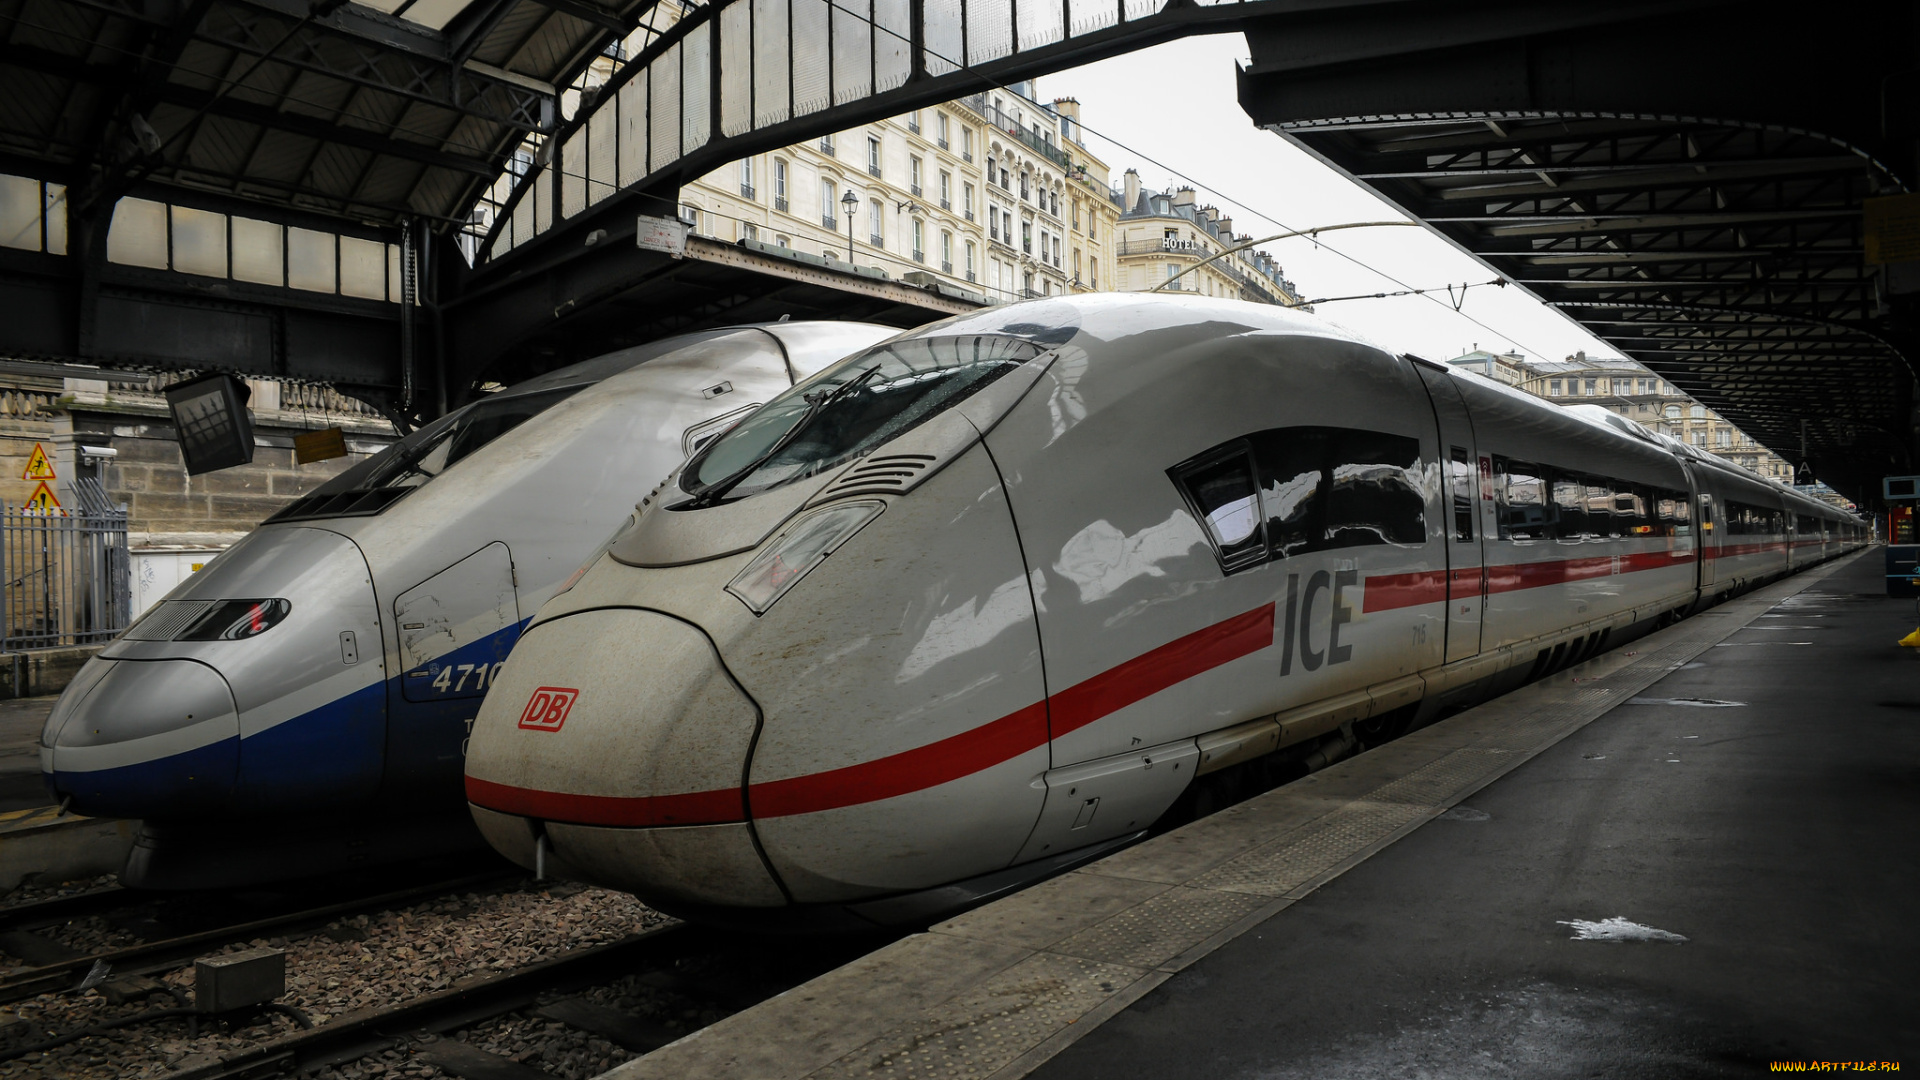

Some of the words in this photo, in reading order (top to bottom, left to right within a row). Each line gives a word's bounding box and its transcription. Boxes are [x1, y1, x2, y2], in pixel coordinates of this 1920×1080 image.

[1162, 237, 1197, 250] HOTEL
[1797, 461, 1812, 475] A
[1280, 570, 1357, 677] ICE
[1412, 624, 1426, 647] 715
[524, 692, 570, 725] DB
